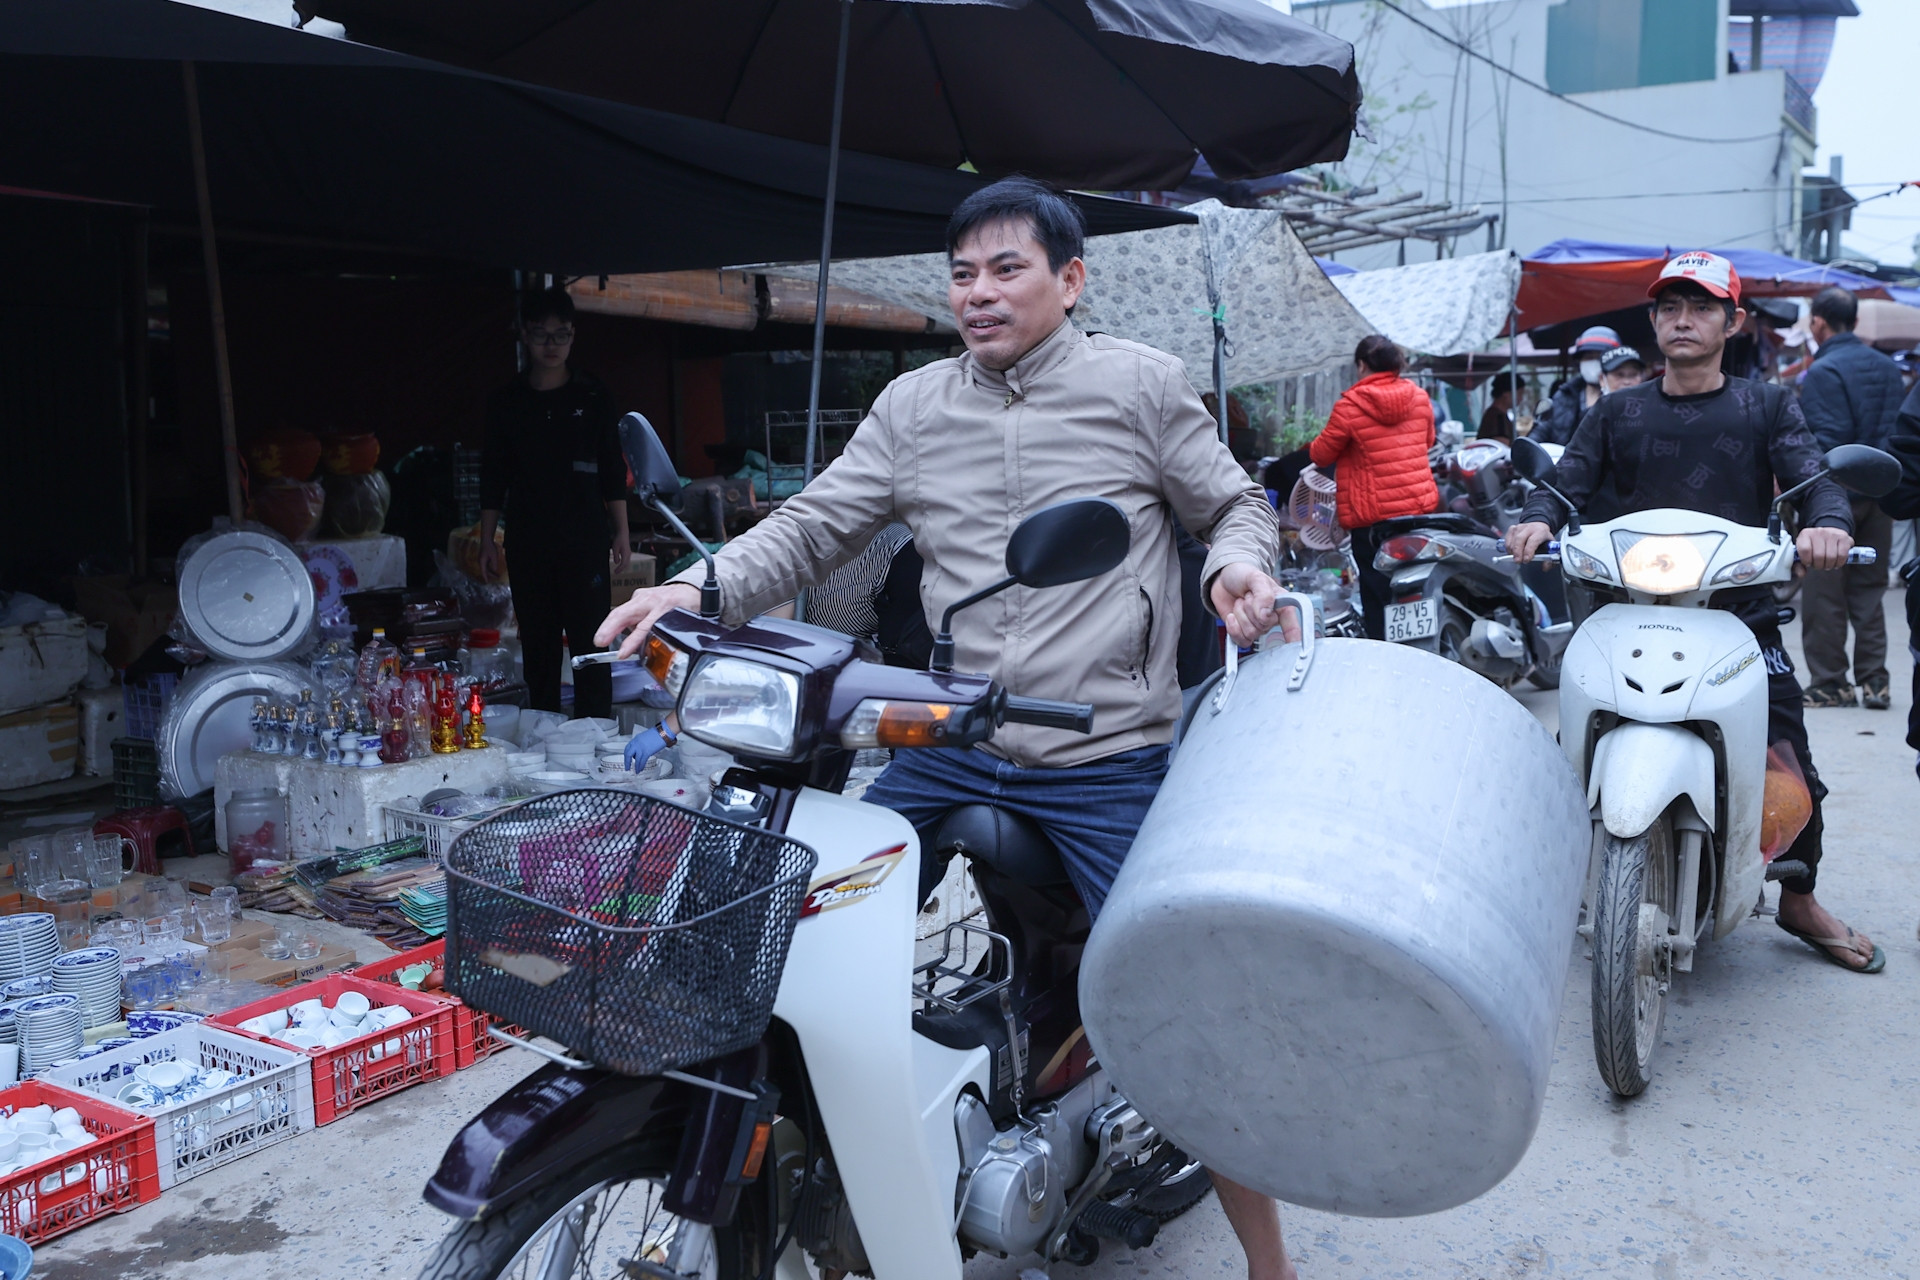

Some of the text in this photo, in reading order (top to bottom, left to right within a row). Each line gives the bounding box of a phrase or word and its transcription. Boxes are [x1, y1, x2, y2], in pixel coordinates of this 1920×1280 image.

[1391, 601, 1428, 623] 29-V5
[1388, 618, 1433, 640] 364.57
[1638, 624, 1684, 633] HONDA
[300, 964, 325, 978] VTC 56
